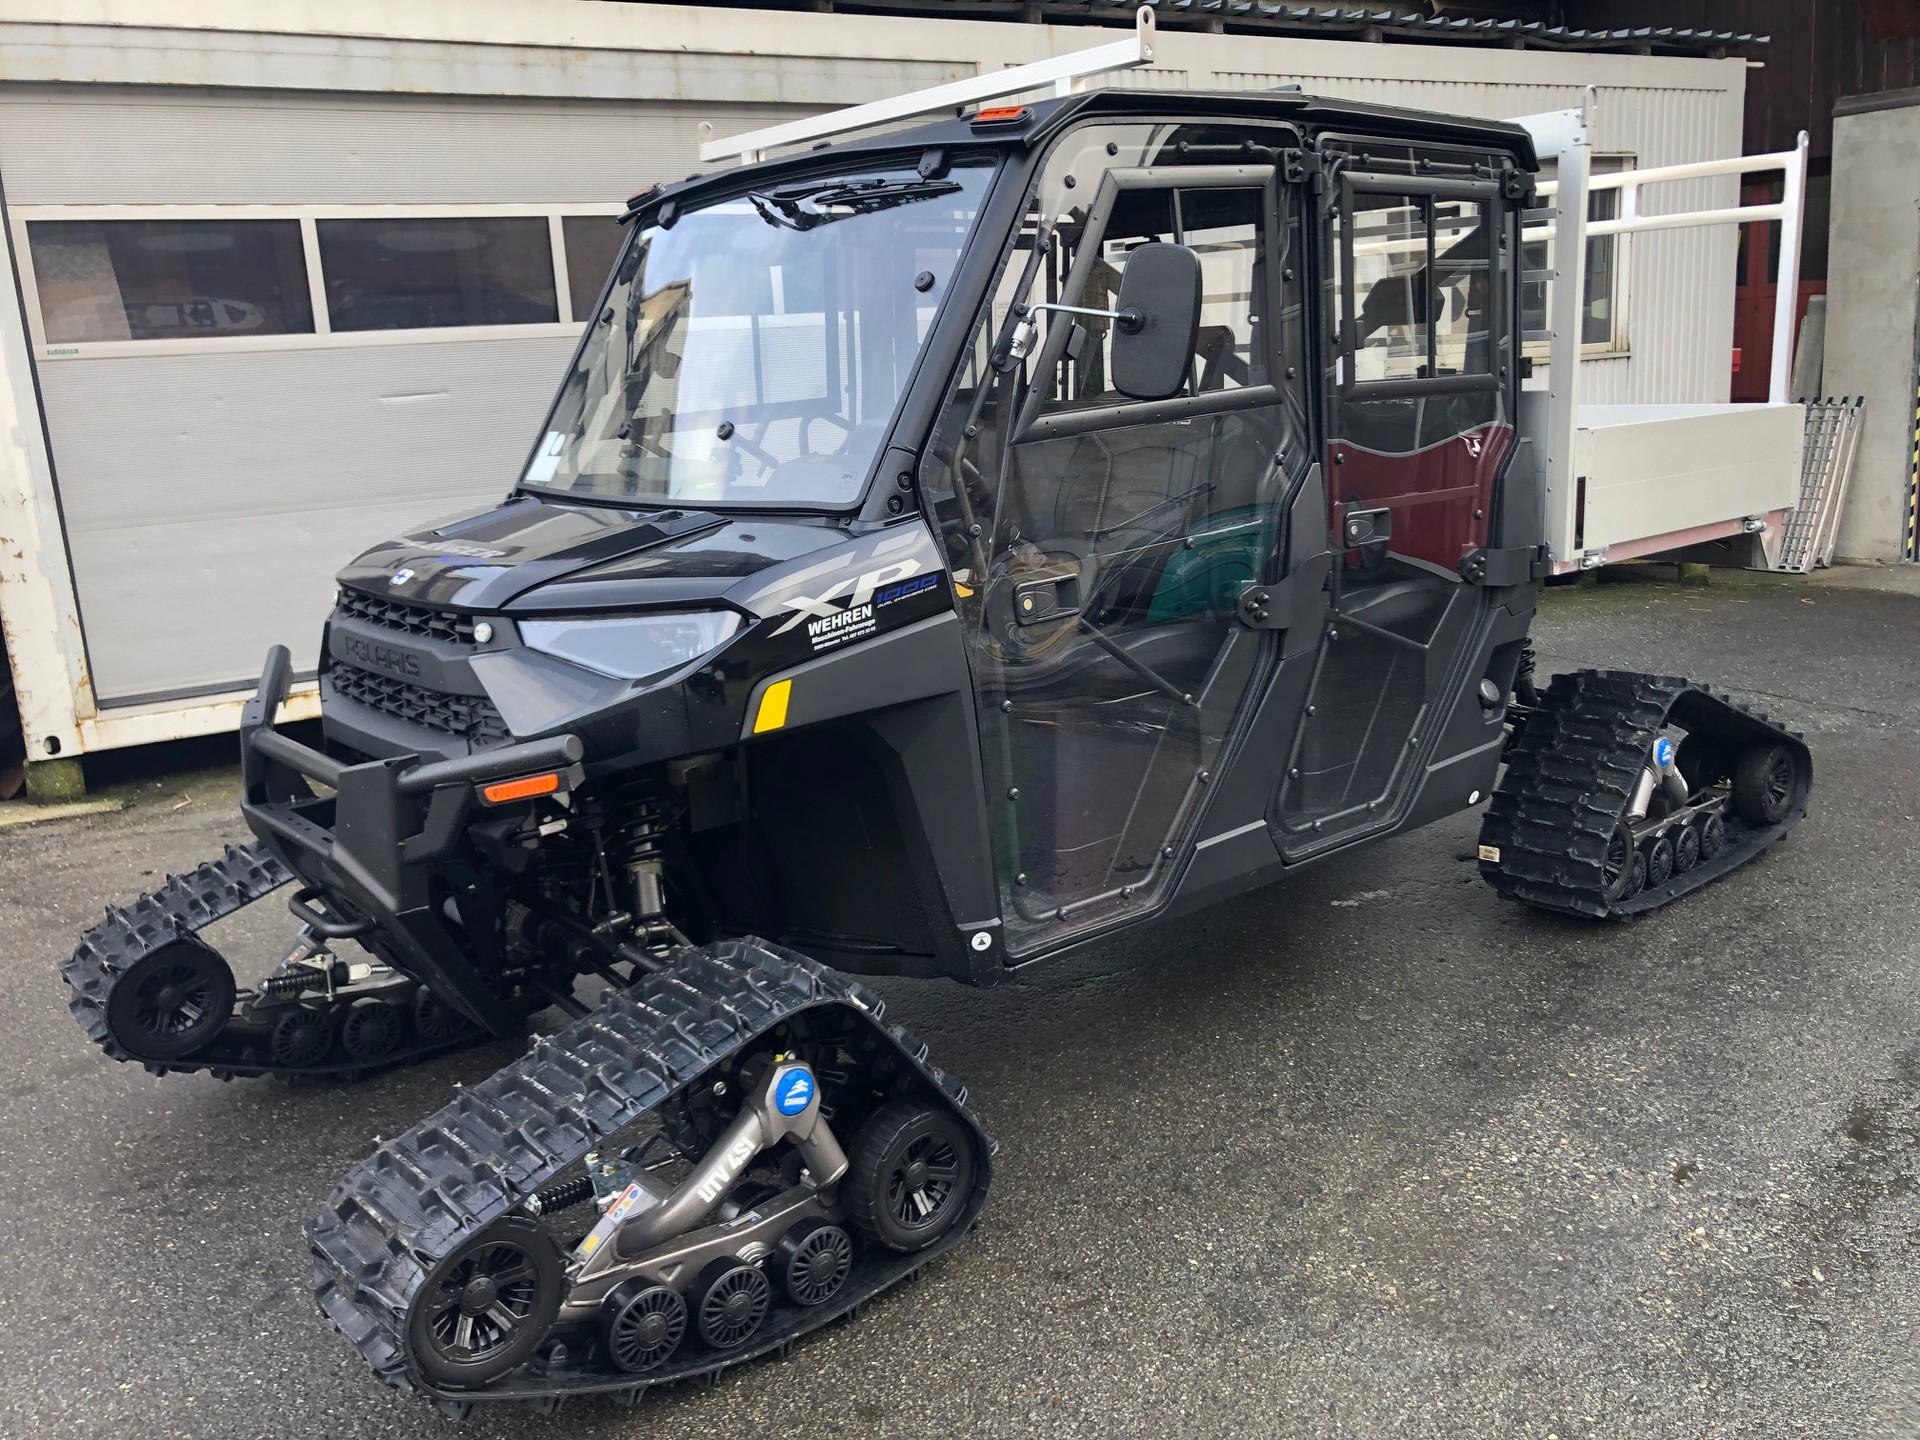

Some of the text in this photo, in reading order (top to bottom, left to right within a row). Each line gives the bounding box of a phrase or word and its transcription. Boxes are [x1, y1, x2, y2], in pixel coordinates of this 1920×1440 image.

[767, 558, 938, 638] XP 1000
[808, 604, 872, 636] WEHREN
[811, 619, 876, 644] Maschinen-Fahrzeuge
[345, 635, 420, 677] POLARIS
[697, 1164, 731, 1203] UTV
